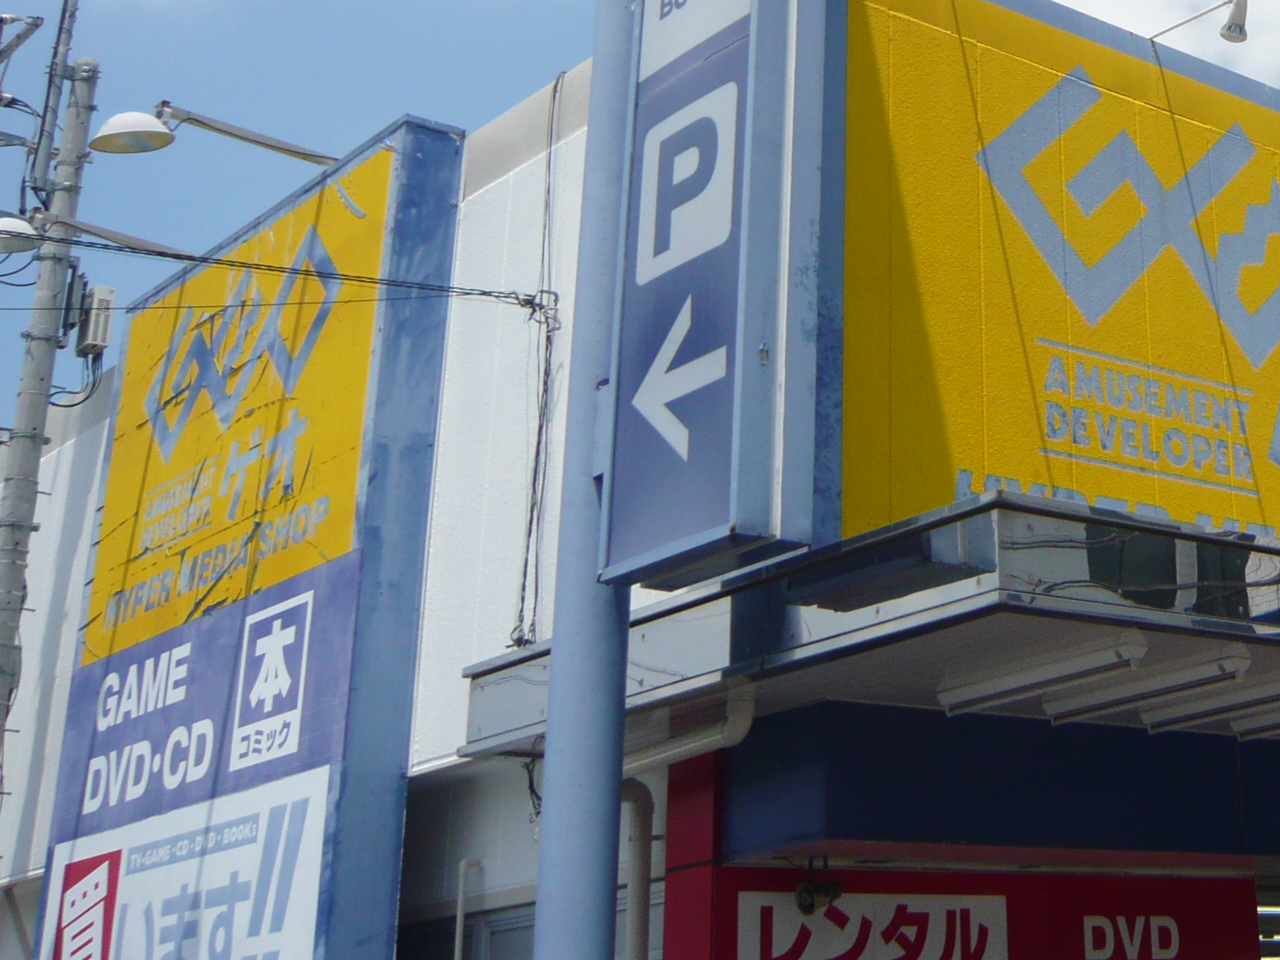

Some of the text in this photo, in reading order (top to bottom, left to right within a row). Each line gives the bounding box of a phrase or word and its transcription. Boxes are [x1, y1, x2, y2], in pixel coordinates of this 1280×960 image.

[653, 116, 719, 258] P
[1044, 355, 1250, 436] AMUSEMENT
[220, 408, 309, 522] ゲオ
[1045, 400, 1254, 482] DEVELOPER
[103, 494, 331, 631] HYPER MEDIA SHOP
[97, 642, 191, 731] GAME
[250, 618, 296, 713] 本
[238, 719, 291, 760] コミック
[759, 903, 989, 960] レンタル
[1083, 914, 1181, 960] DVD
